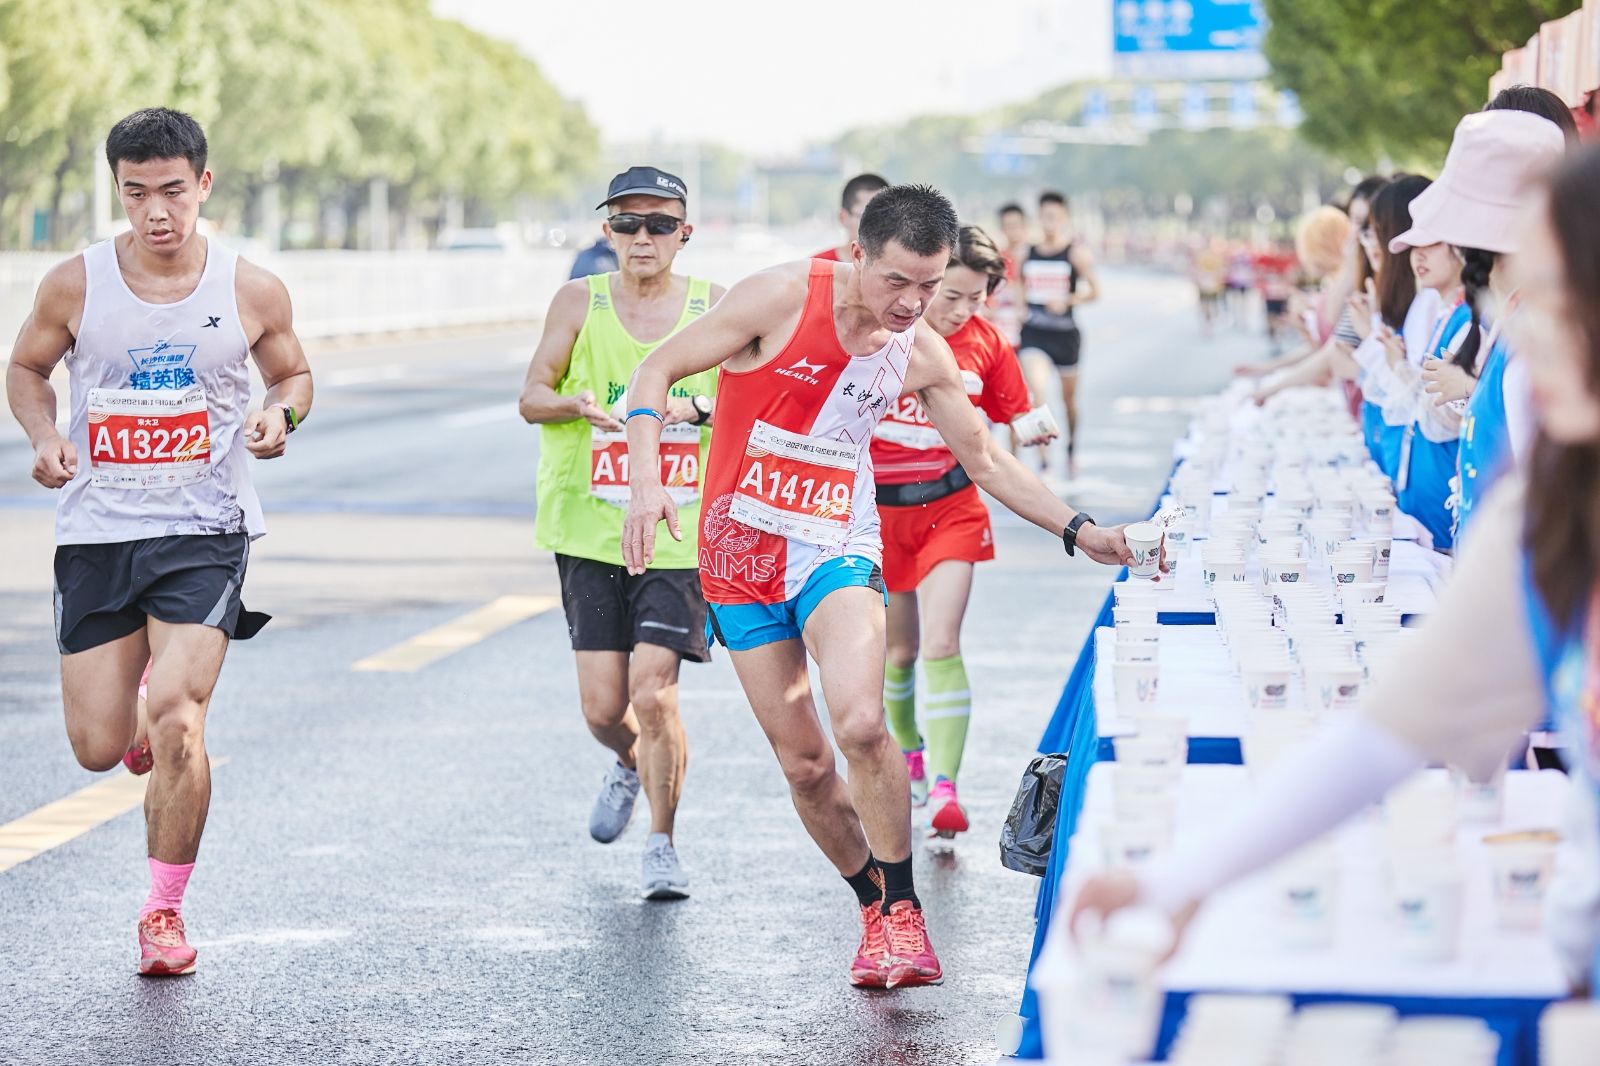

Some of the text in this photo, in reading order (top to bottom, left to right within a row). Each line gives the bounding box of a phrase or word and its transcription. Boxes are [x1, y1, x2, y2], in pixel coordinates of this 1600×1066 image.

[129, 368, 196, 390] 精英隊
[773, 368, 819, 385] HEALTH
[93, 425, 208, 459] A13222
[593, 452, 699, 483] A170
[740, 461, 850, 515] A14149
[699, 548, 777, 582] AIMS
